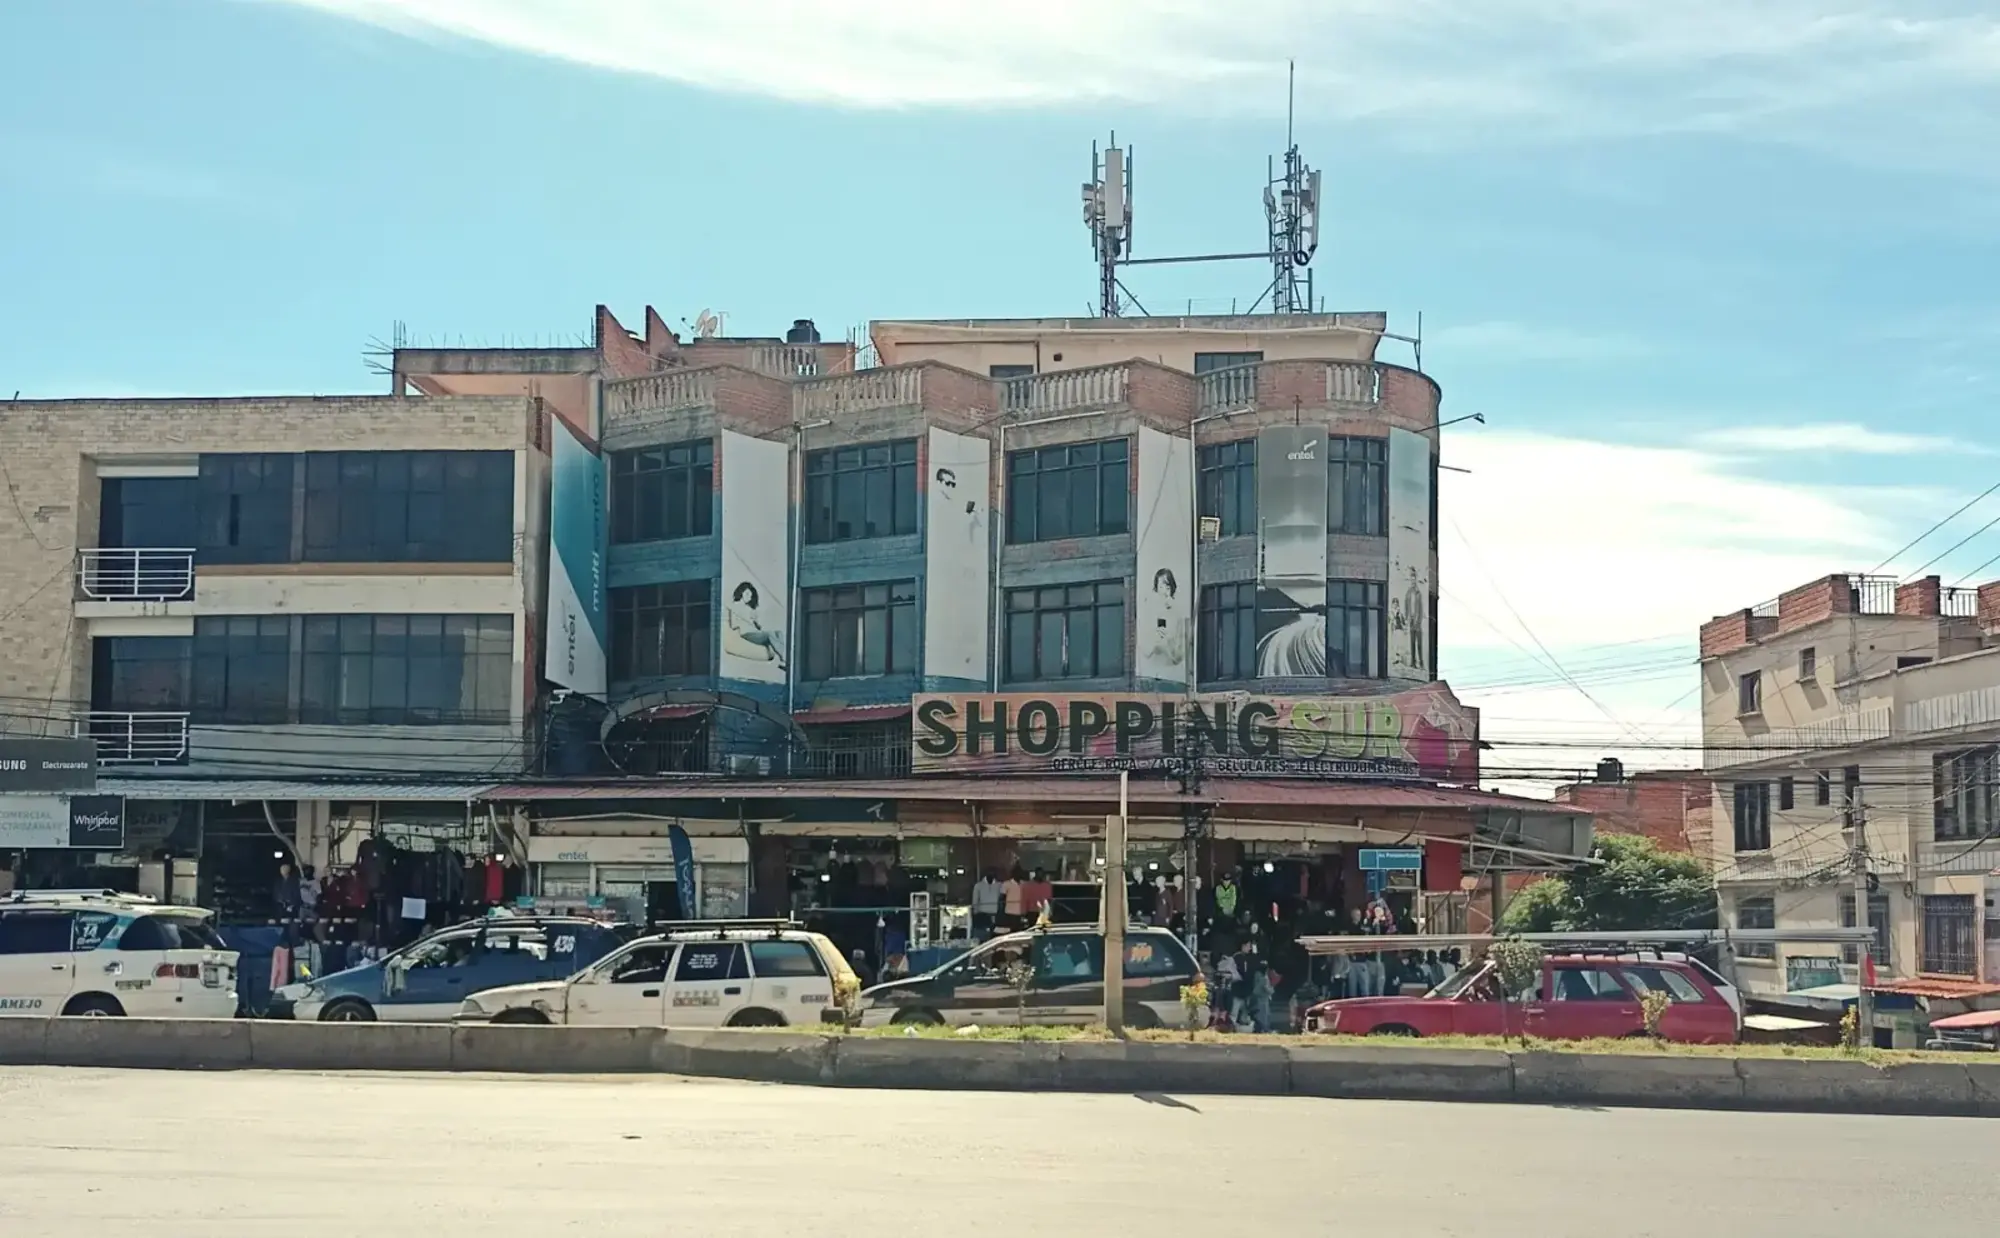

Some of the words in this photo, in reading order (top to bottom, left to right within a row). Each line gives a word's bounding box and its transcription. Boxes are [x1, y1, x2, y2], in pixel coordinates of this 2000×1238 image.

[1287, 450, 1315, 460] entel
[592, 473, 601, 612] multicentro
[568, 613, 576, 677] entel
[916, 699, 1281, 758] SHOPPING
[1290, 699, 1403, 758] SUR
[1106, 757, 1136, 771] ROPA
[1151, 757, 1205, 773] ZAPAS
[1218, 758, 1287, 774] CELULARES
[74, 814, 119, 827] Whirlpool
[557, 850, 589, 860] entel
